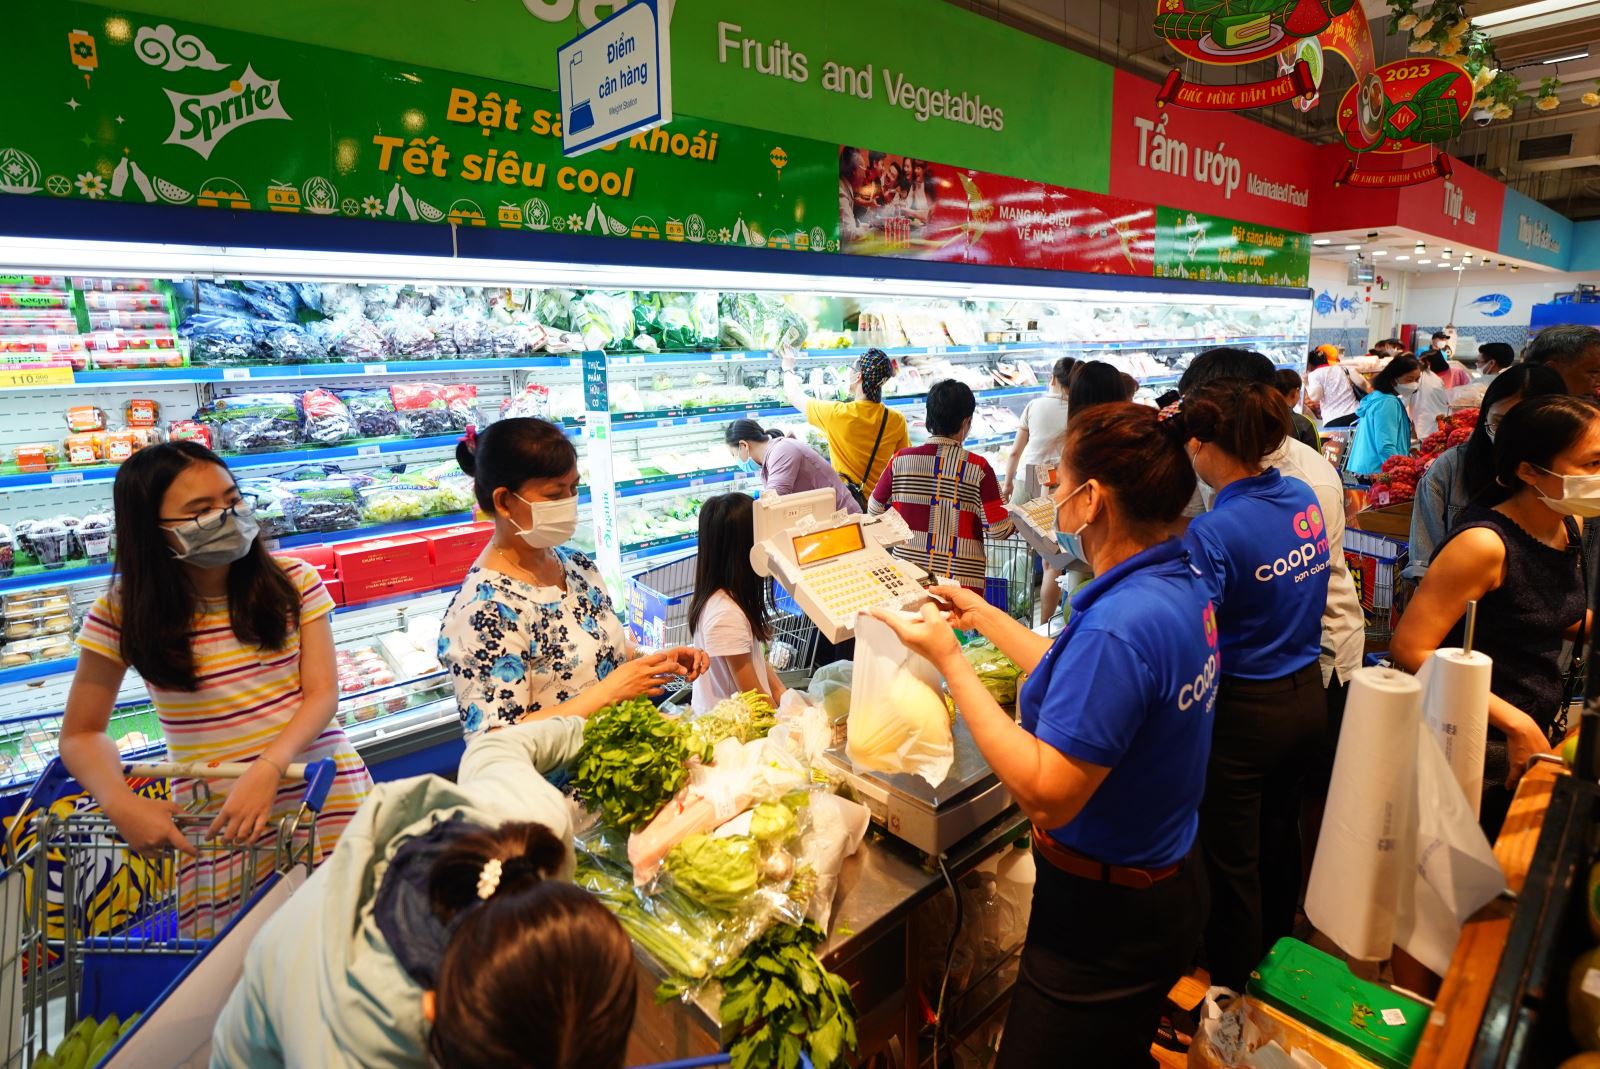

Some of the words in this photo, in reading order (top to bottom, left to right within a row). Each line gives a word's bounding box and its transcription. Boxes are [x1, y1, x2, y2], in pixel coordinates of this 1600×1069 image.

[607, 32, 635, 64] Điểm
[599, 76, 618, 99] cân
[620, 62, 648, 90] hàng
[717, 21, 809, 83] Fruits
[822, 61, 873, 99] and
[883, 69, 1004, 131] Vegetables
[1386, 64, 1431, 82] 2023
[608, 103, 623, 116] Weight
[623, 97, 638, 111] Station
[1178, 88, 1203, 103] CHÚC
[1207, 89, 1236, 105] MỪNG
[1271, 79, 1294, 97] MỚI
[180, 80, 275, 142] Sprite
[446, 88, 521, 137] Bật
[373, 135, 450, 177] Tết
[461, 150, 546, 188] siêu
[557, 167, 635, 198] cool
[1134, 113, 1188, 177] Tẩm
[1193, 142, 1241, 199] ướp
[1247, 173, 1289, 201] Marinated
[1289, 184, 1309, 208] Food
[1000, 205, 1031, 220] MANG
[1444, 181, 1463, 225] Thịt
[1017, 223, 1031, 240] VỀ
[1033, 227, 1055, 243] NHÀ
[1294, 570, 1309, 583] bạn
[1310, 563, 1326, 575] của
